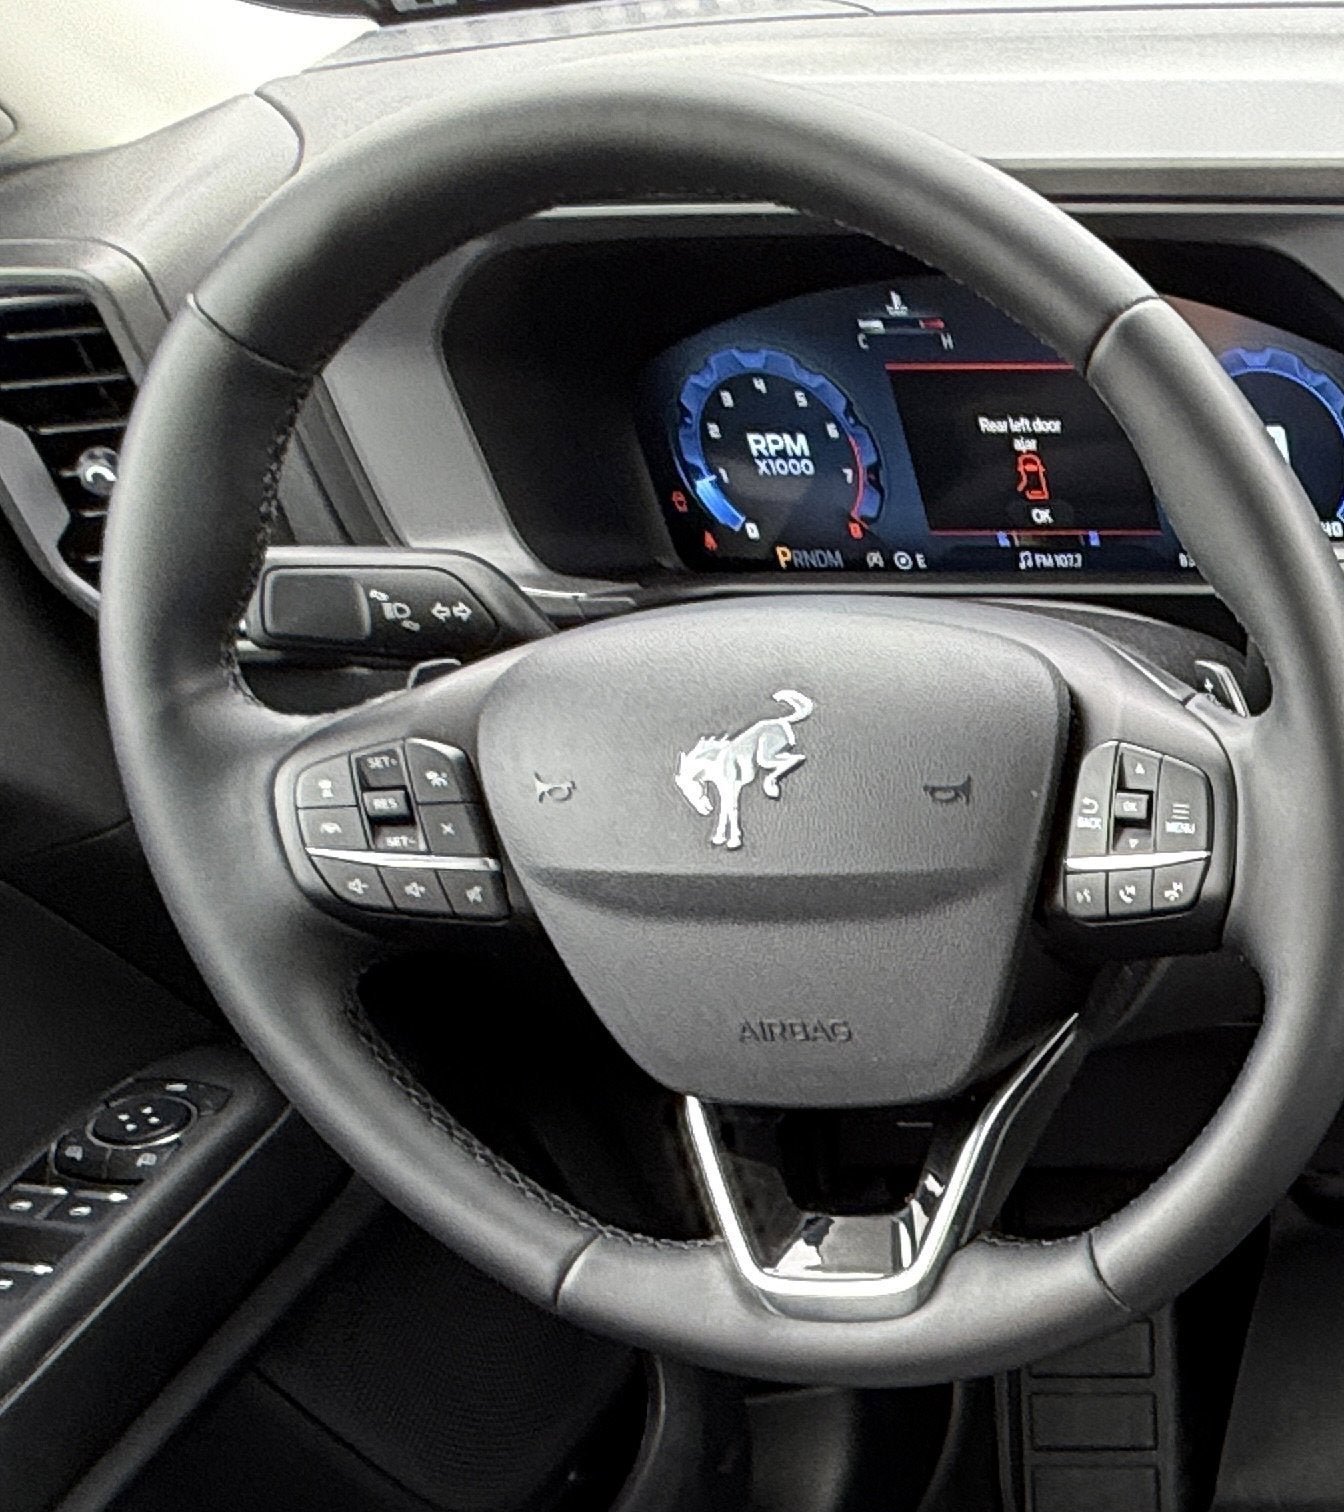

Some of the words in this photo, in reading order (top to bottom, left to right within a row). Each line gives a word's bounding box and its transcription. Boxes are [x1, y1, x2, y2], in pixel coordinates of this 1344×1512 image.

[857, 332, 870, 350] C
[940, 332, 955, 350] H
[753, 377, 767, 394] 4
[794, 390, 808, 408] 5
[706, 422, 722, 440] 2
[826, 422, 840, 439] 6
[1032, 416, 1061, 433] door
[746, 432, 812, 457] RPM
[718, 467, 730, 484] 1
[842, 468, 854, 484] 7
[1031, 508, 1054, 523] OK
[739, 1019, 853, 1042] AIRBAG
